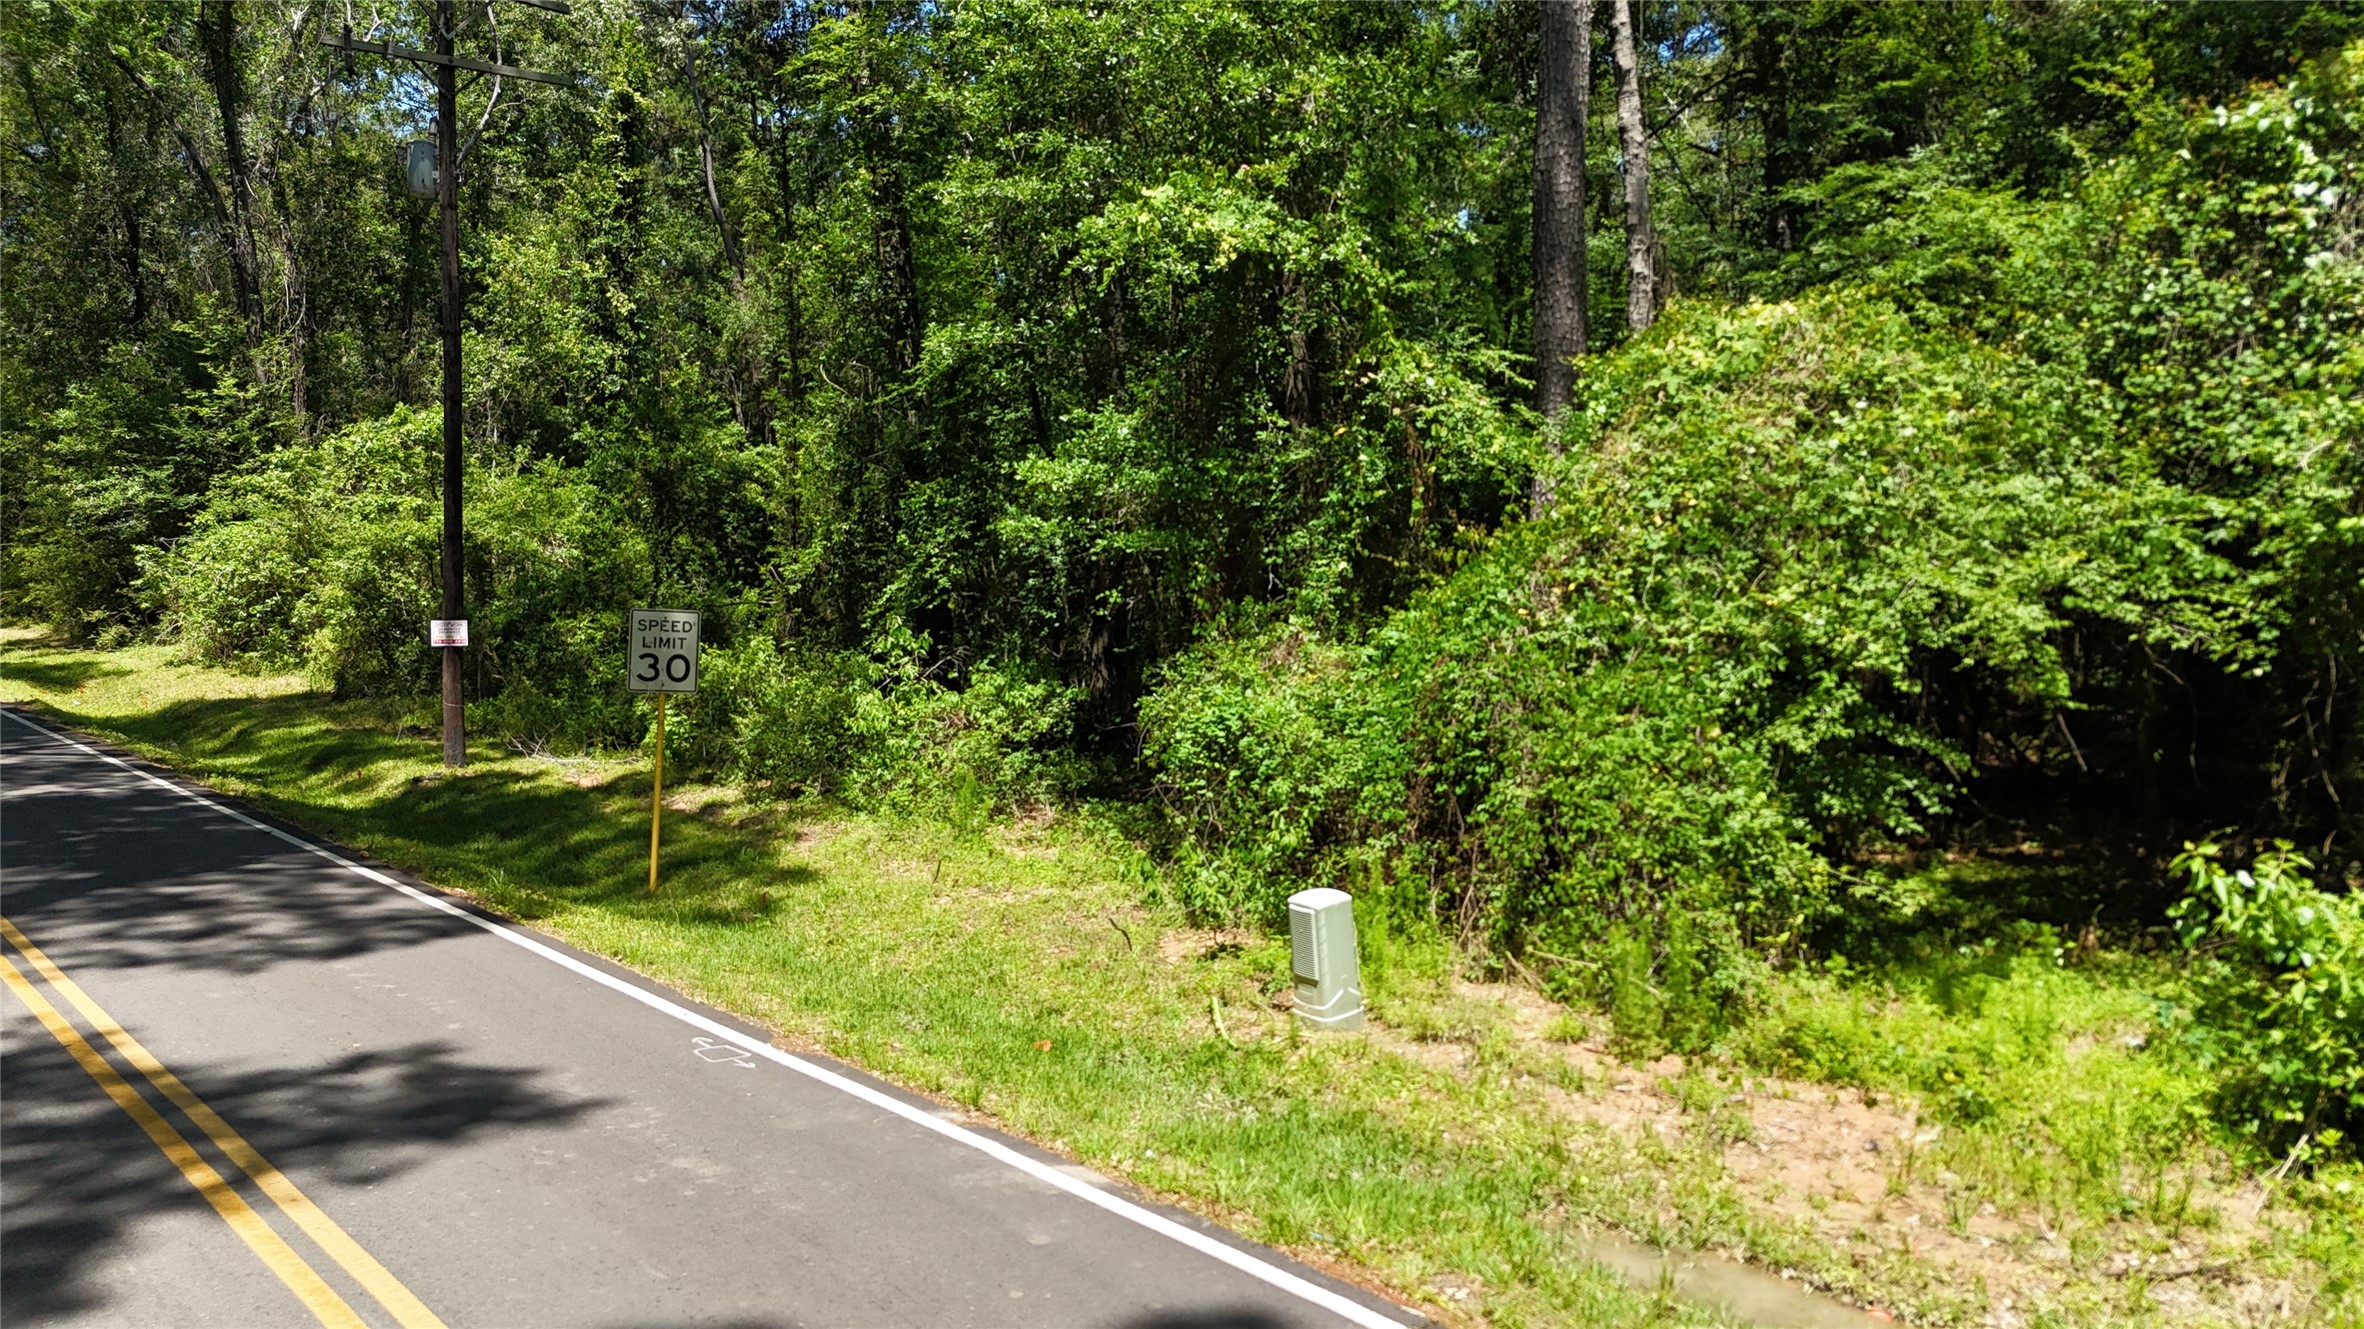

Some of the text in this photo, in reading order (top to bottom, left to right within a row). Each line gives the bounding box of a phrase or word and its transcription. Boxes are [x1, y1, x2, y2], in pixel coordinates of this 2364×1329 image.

[638, 619, 692, 633] SPEED
[642, 636, 687, 649] LIMIT
[636, 653, 691, 683] 30
